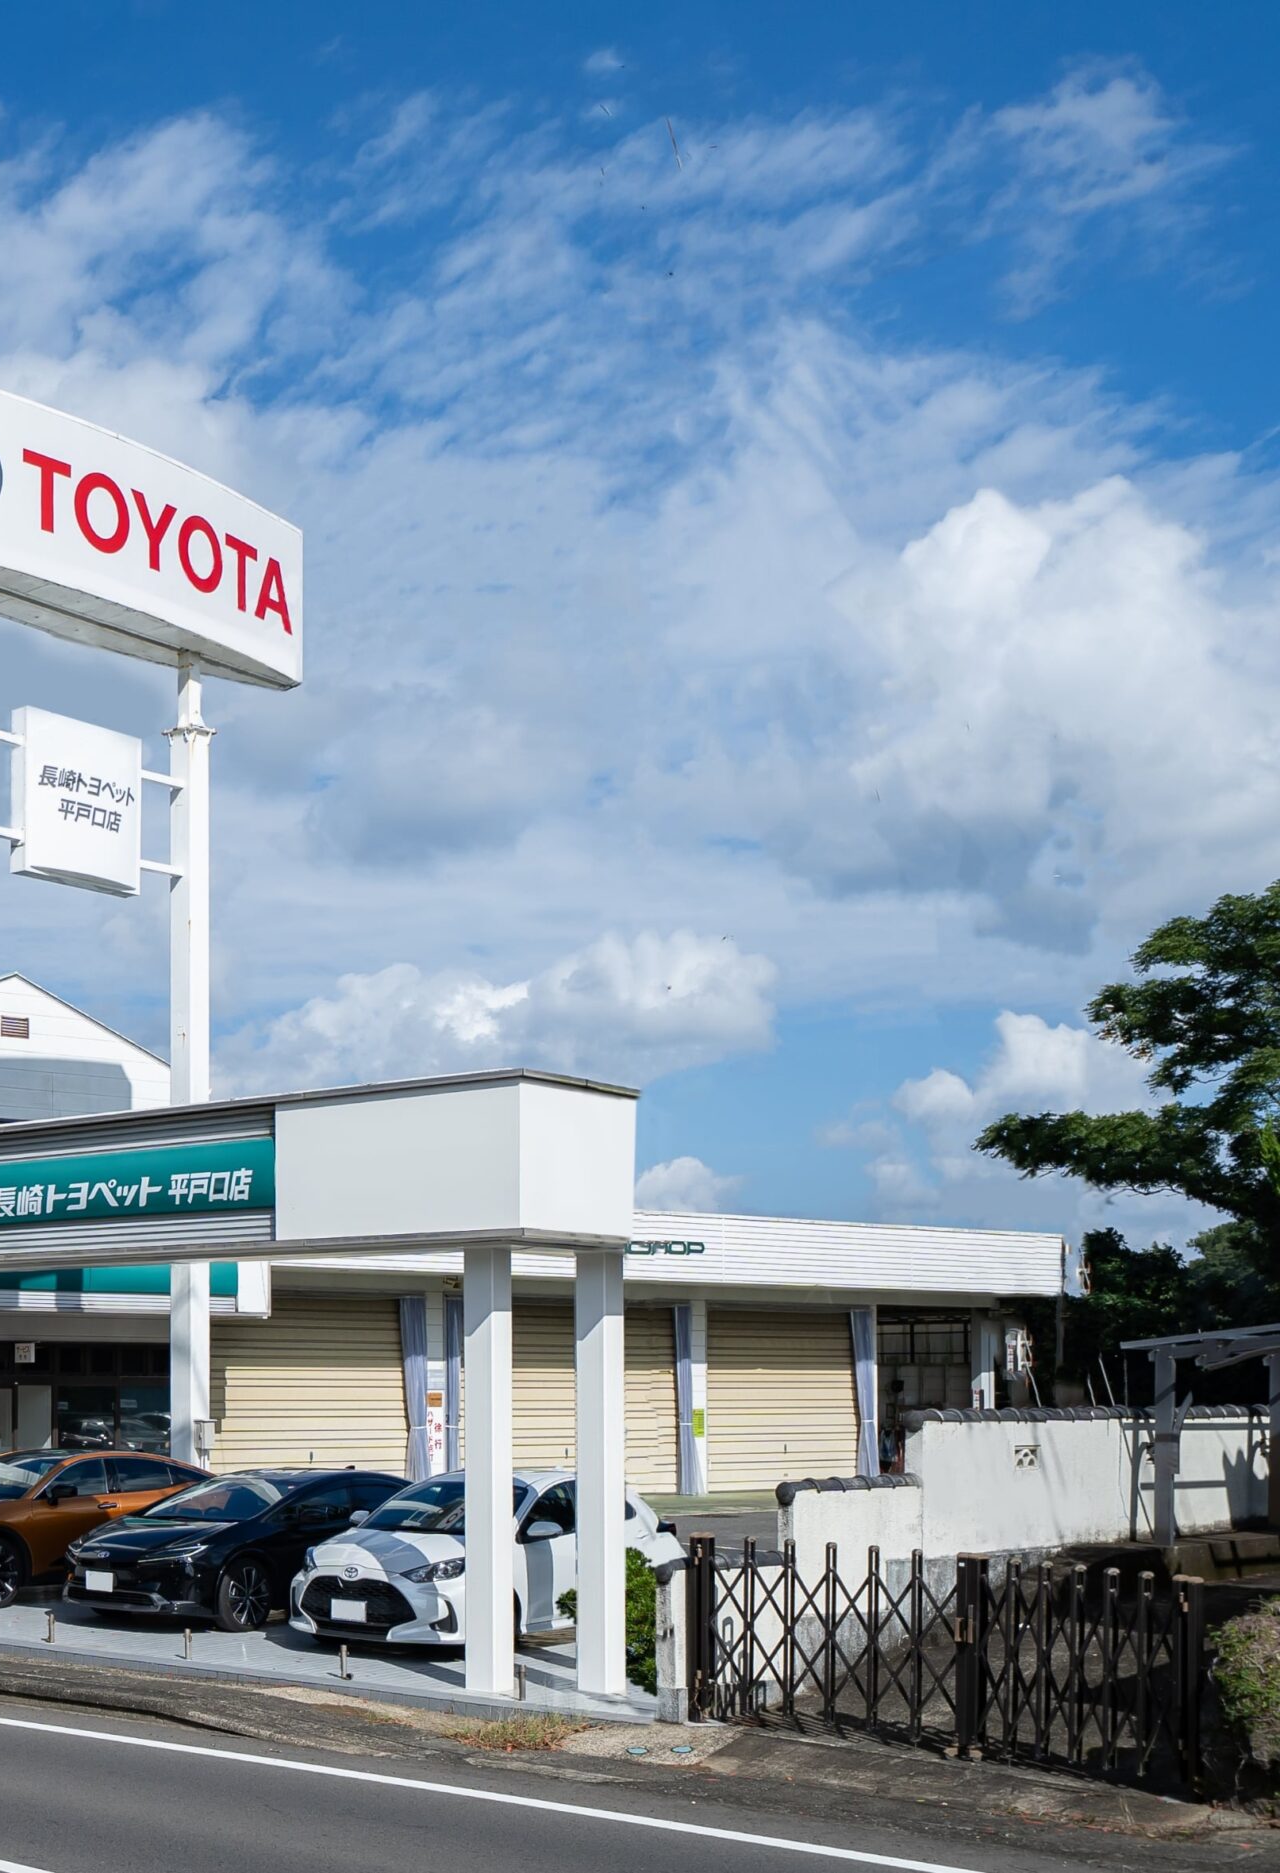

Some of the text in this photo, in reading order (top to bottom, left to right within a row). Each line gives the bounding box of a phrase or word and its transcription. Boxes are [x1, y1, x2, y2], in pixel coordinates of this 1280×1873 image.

[23, 448, 293, 635] TOYOTA
[38, 765, 135, 806] 長崎トヨペット
[58, 798, 122, 833] 平戸口店
[168, 1167, 254, 1205] 平戸口店
